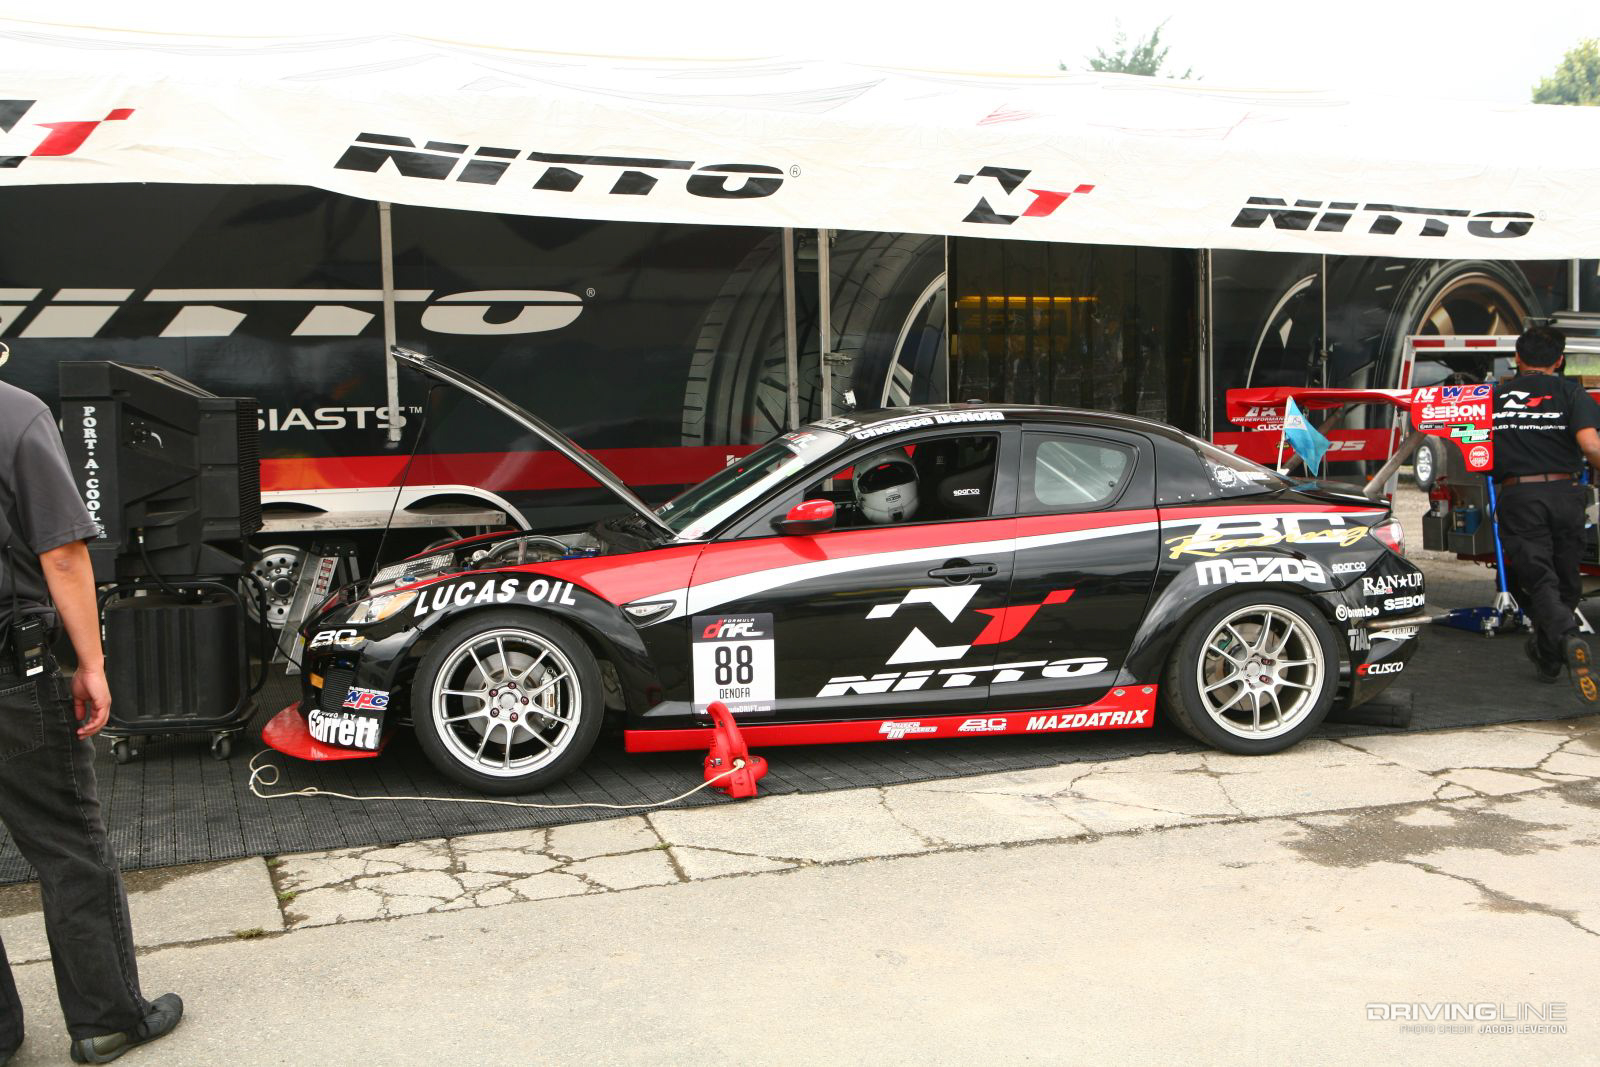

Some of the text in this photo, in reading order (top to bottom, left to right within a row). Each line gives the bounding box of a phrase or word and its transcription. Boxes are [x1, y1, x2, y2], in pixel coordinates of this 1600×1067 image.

[333, 132, 785, 199] NITTO
[1231, 196, 1536, 238] NITTO
[0, 288, 583, 338] ITTO
[257, 406, 407, 431] IASTS
[414, 578, 576, 618] LUCAS OIL
[715, 645, 753, 686] 88
[815, 656, 1109, 698] NITTO
[720, 687, 751, 699] DENOFA
[308, 709, 379, 749] Garrett
[1026, 710, 1148, 731] MAZDATRIX
